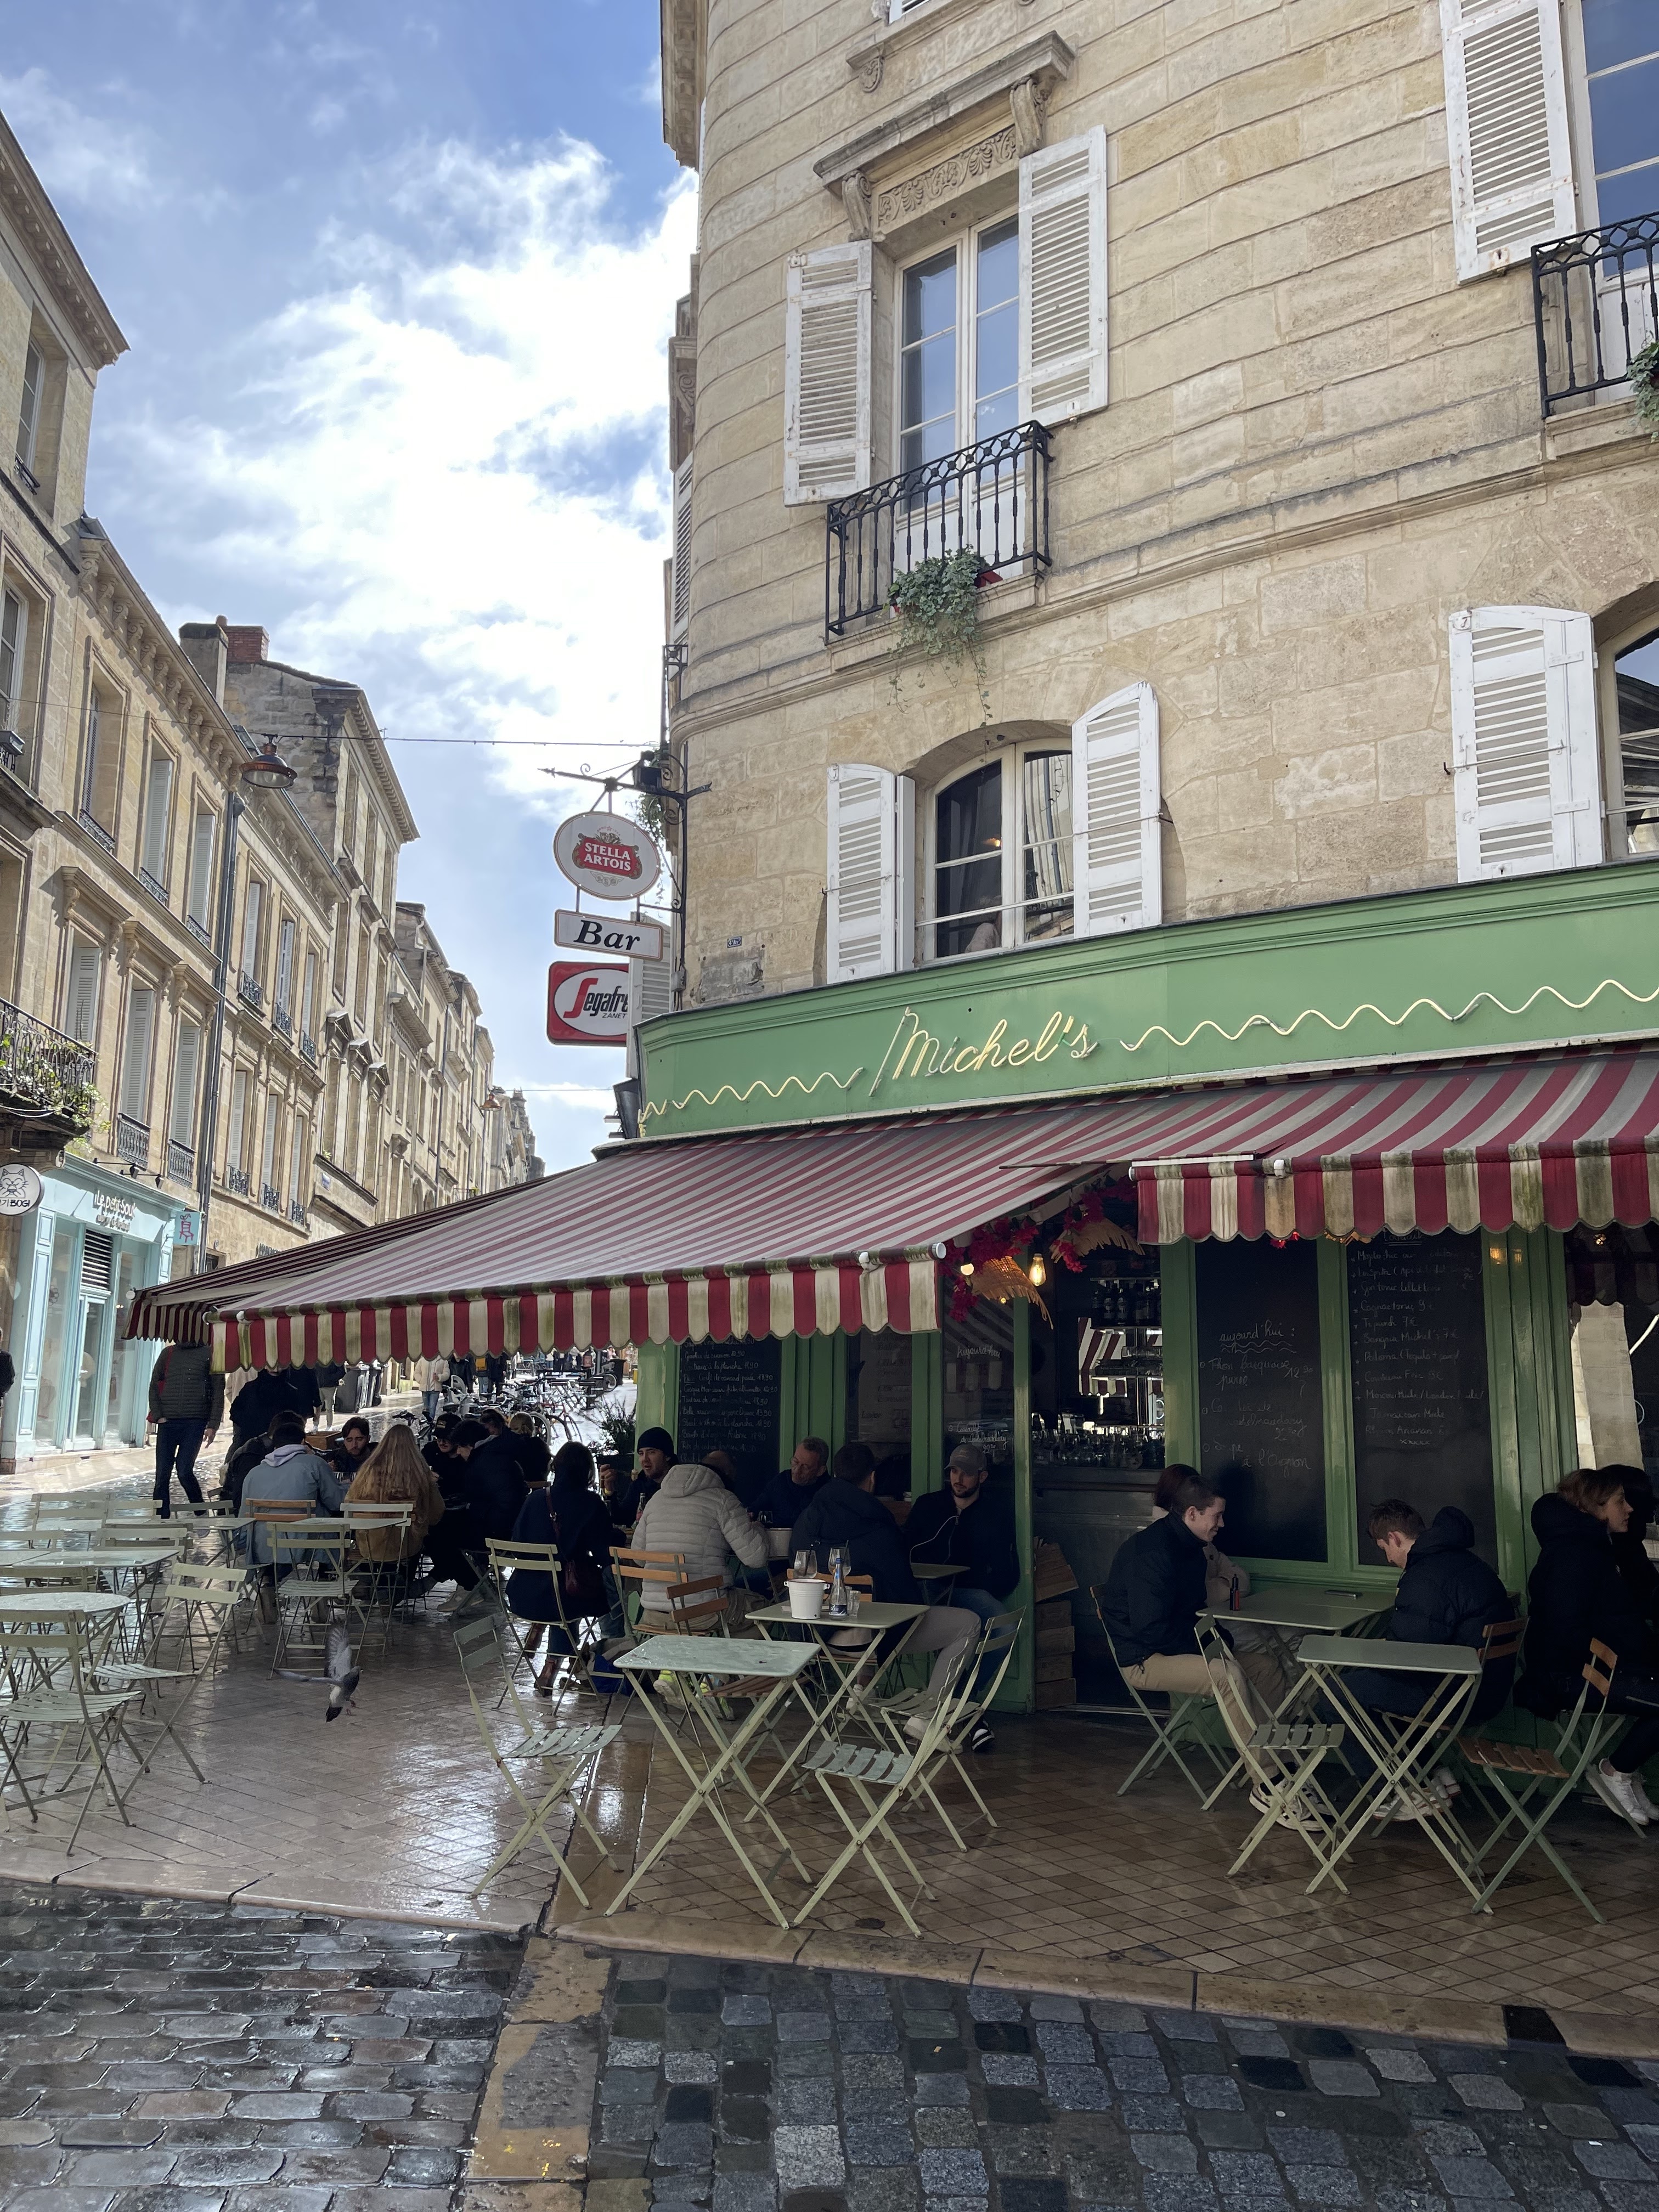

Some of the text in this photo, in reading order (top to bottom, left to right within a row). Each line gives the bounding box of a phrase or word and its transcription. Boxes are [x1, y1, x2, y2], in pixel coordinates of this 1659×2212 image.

[585, 843, 630, 860] STELLA
[584, 854, 631, 871] ARTOIS
[573, 919, 640, 950] Bar
[869, 1006, 1098, 1096] Michel's
[1208, 1357, 1234, 1371] Thon
